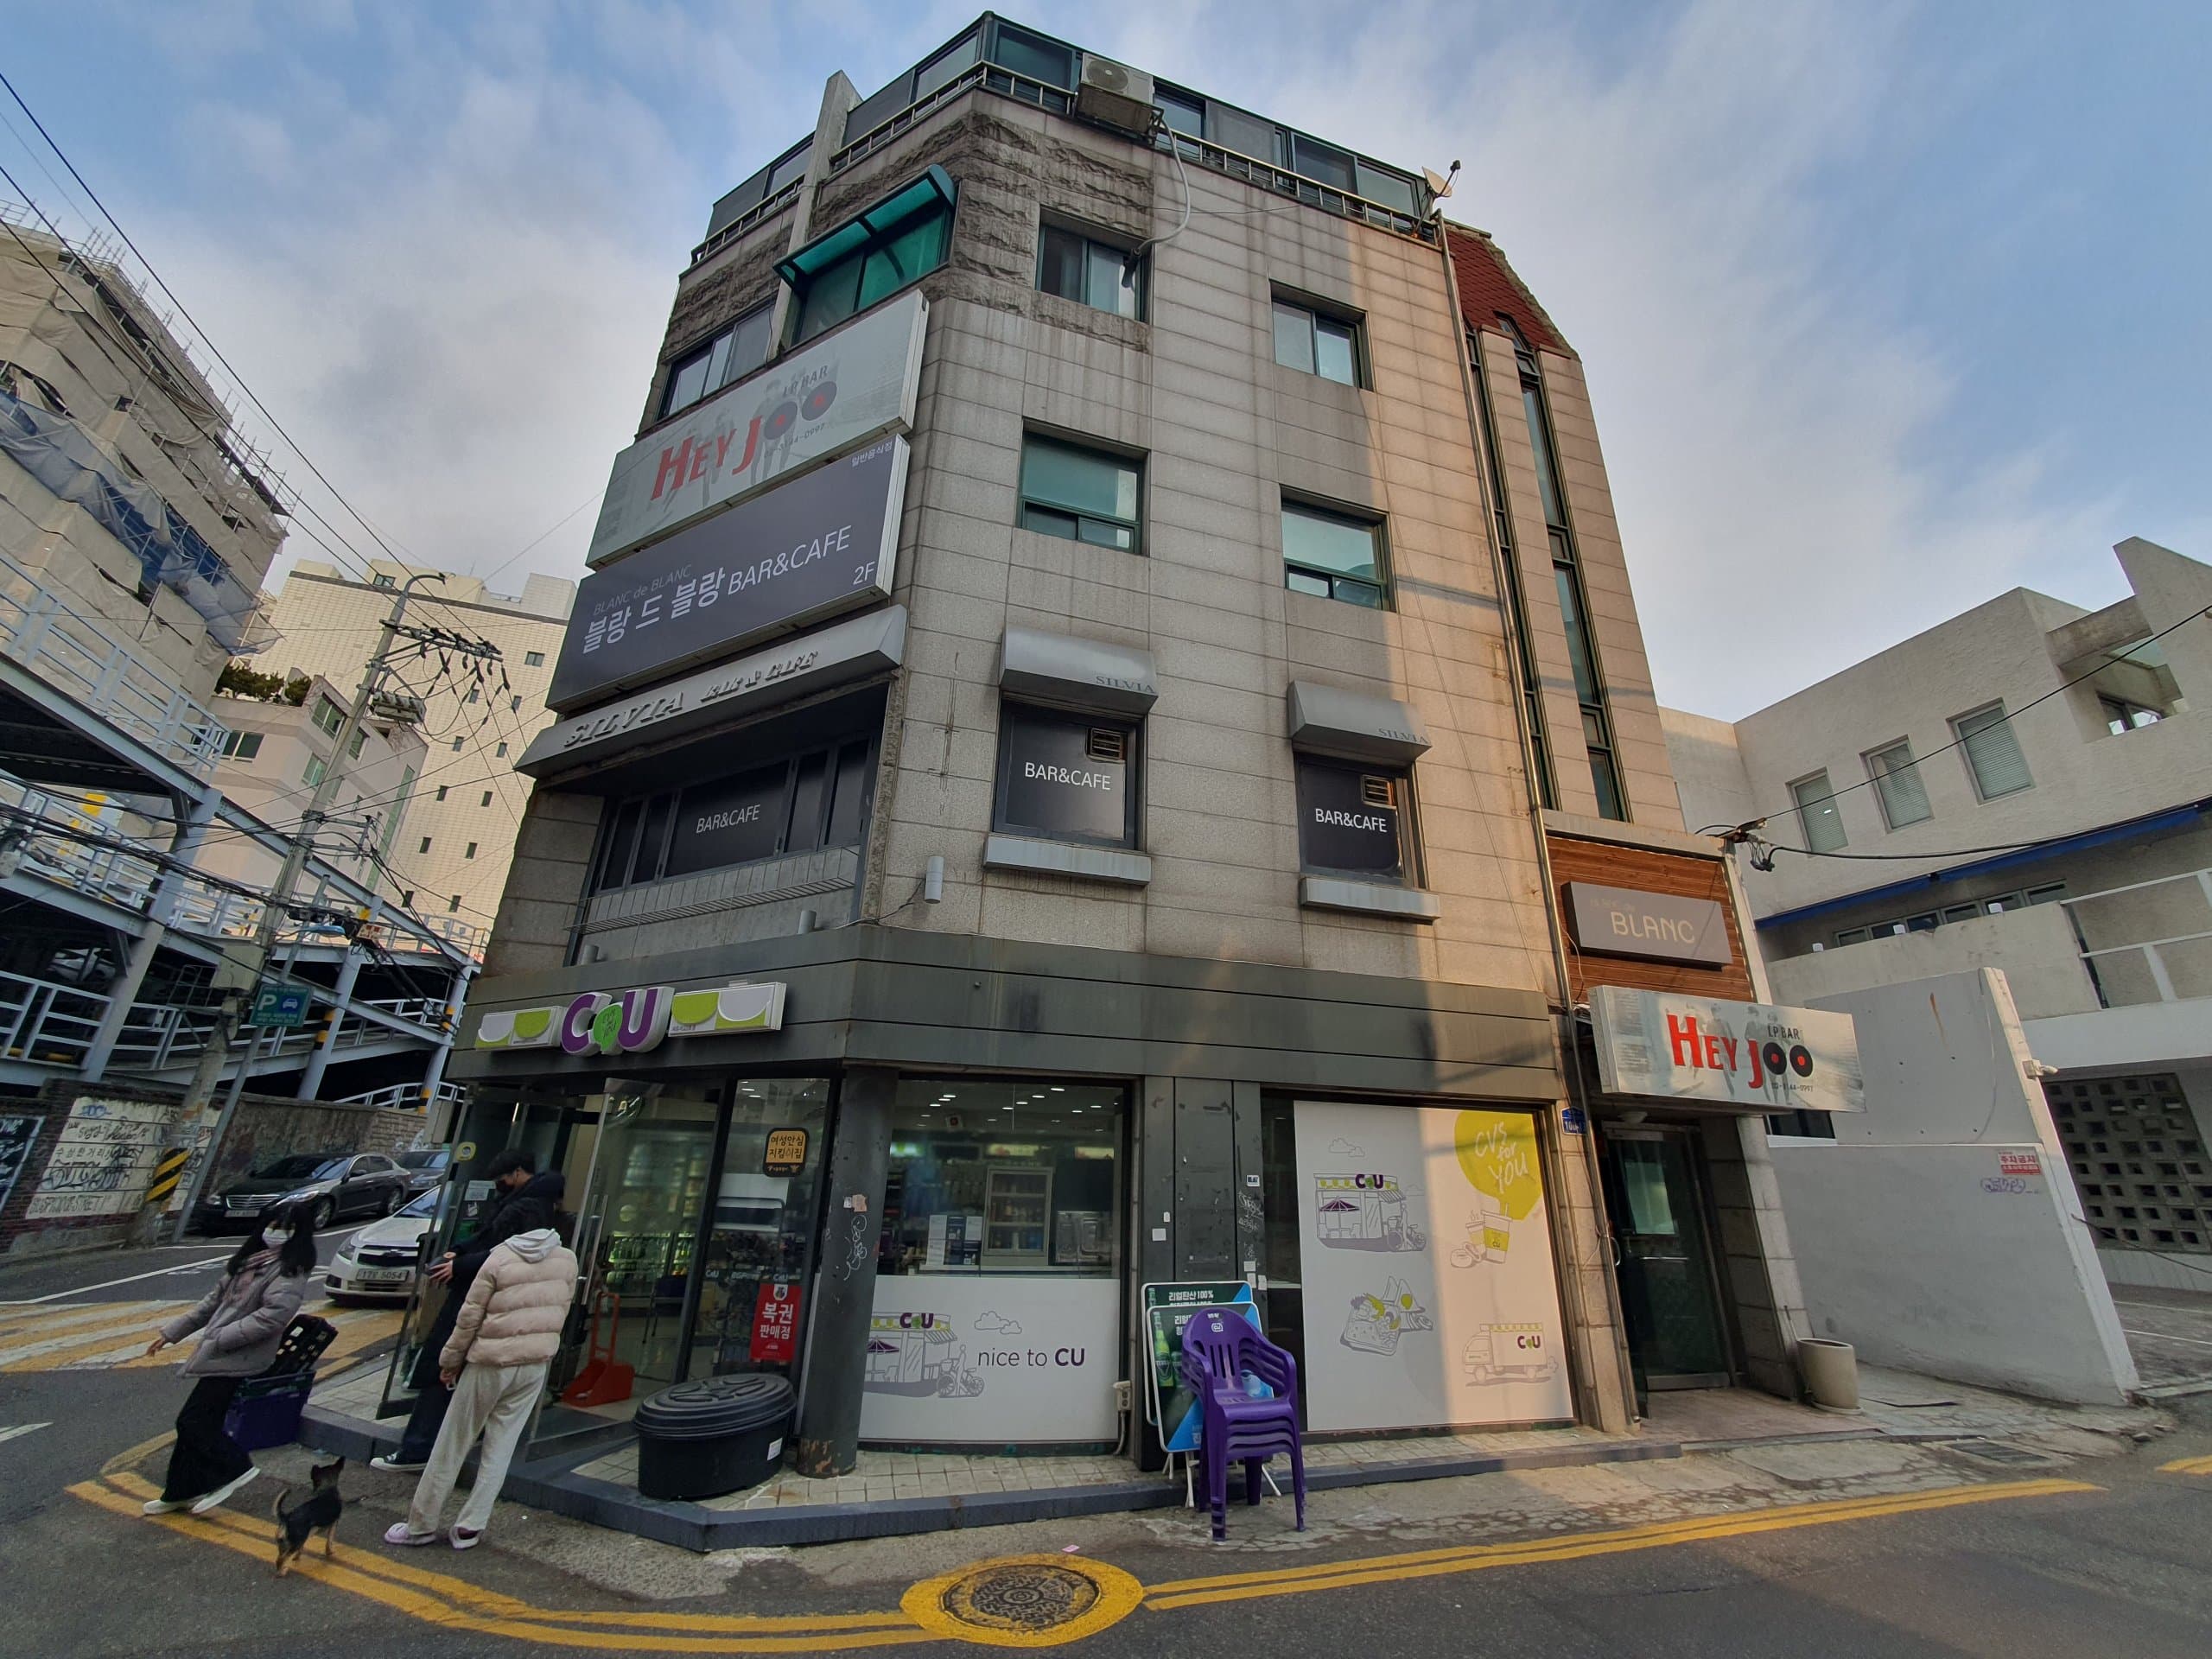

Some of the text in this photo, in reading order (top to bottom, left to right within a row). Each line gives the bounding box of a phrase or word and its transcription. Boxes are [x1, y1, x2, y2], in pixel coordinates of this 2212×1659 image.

[801, 365, 829, 386] BAR
[650, 429, 738, 501] HEY
[852, 562, 876, 587] 2F
[582, 525, 853, 655] 블랑 드 블랑 BAR&CAFE
[594, 563, 692, 616] BLANC de BLANC
[1095, 675, 1155, 694] SILVIA
[563, 691, 684, 748] SILVIA
[1377, 728, 1429, 746] SILVIA
[1024, 761, 1111, 791] BAR&CAFE
[696, 804, 761, 835] BAR&CAFE
[1315, 808, 1388, 834] BAR&CAFE
[1610, 912, 1695, 944] BLANC
[562, 988, 660, 1052] CU
[1667, 1014, 1738, 1072] HEY
[1767, 1025, 1800, 1039] LP BAR
[770, 1134, 804, 1147] 여성안심
[768, 1148, 802, 1160] 지킴이집
[1355, 1173, 1384, 1190] CU
[1487, 1151, 1529, 1195] YOU
[1168, 1290, 1214, 1301] 리얼탄산 100%
[762, 1302, 793, 1324] 복권
[899, 1313, 934, 1329] CU
[760, 1325, 791, 1339] 판매점
[1517, 1335, 1541, 1349] CU
[978, 1346, 1085, 1367] nice to CU
